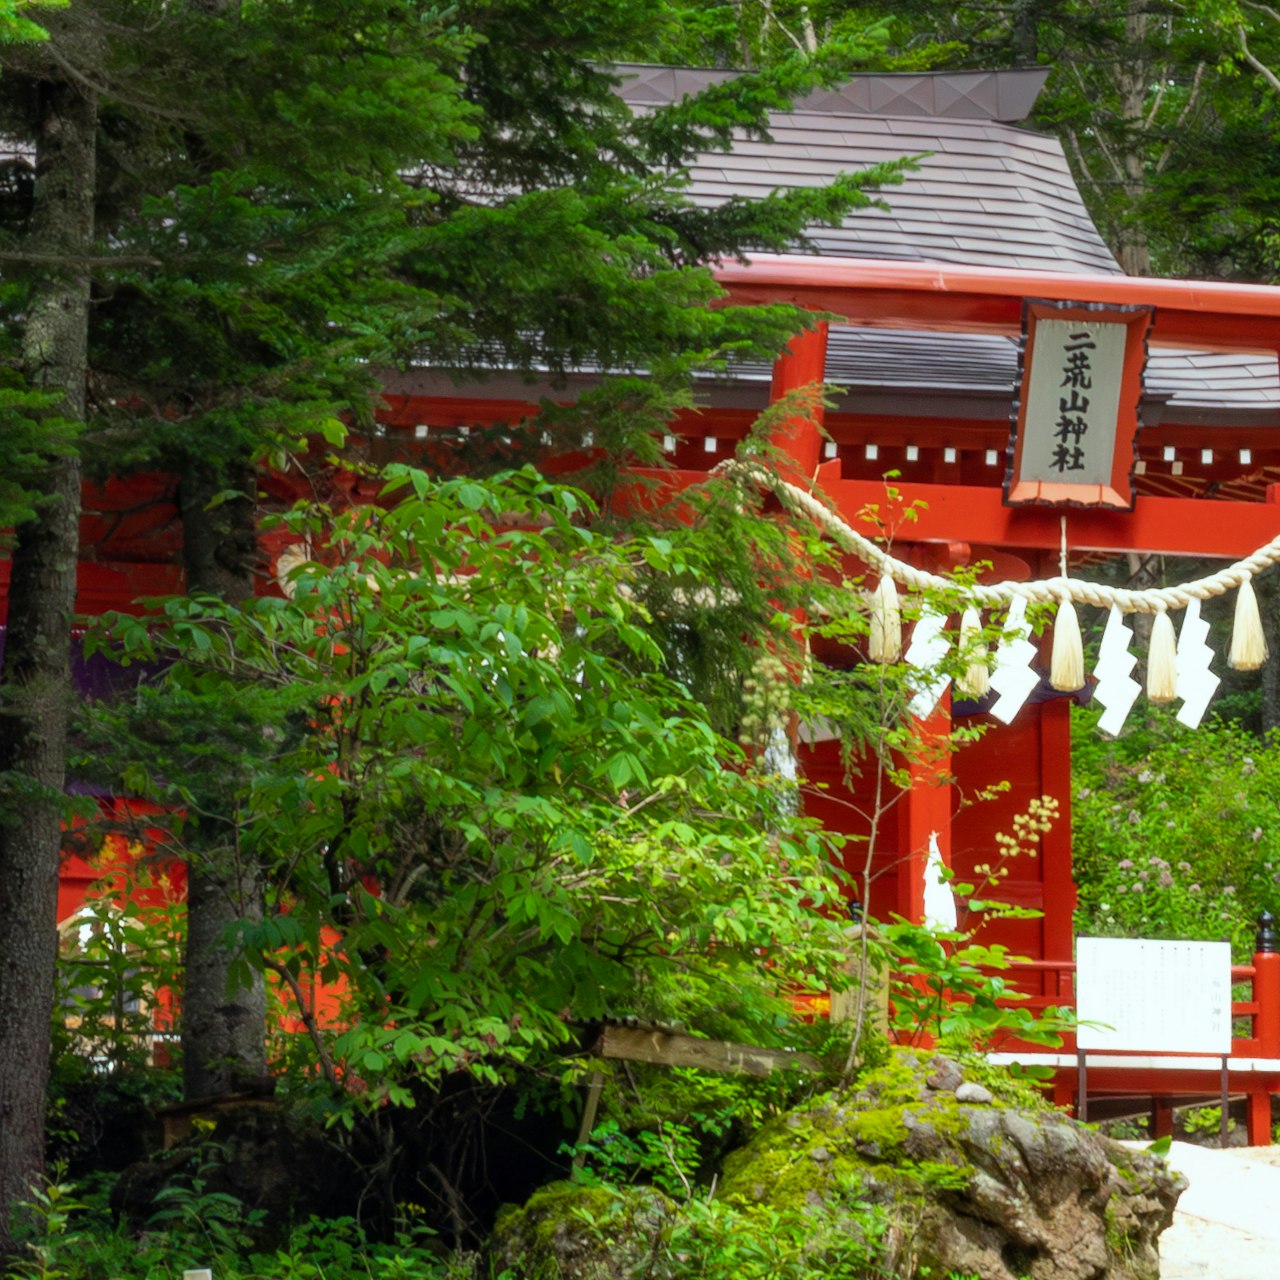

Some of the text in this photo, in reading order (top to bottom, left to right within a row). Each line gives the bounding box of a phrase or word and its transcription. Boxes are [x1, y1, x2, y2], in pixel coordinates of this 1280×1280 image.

[1049, 332, 1096, 472] 二荒山神社
